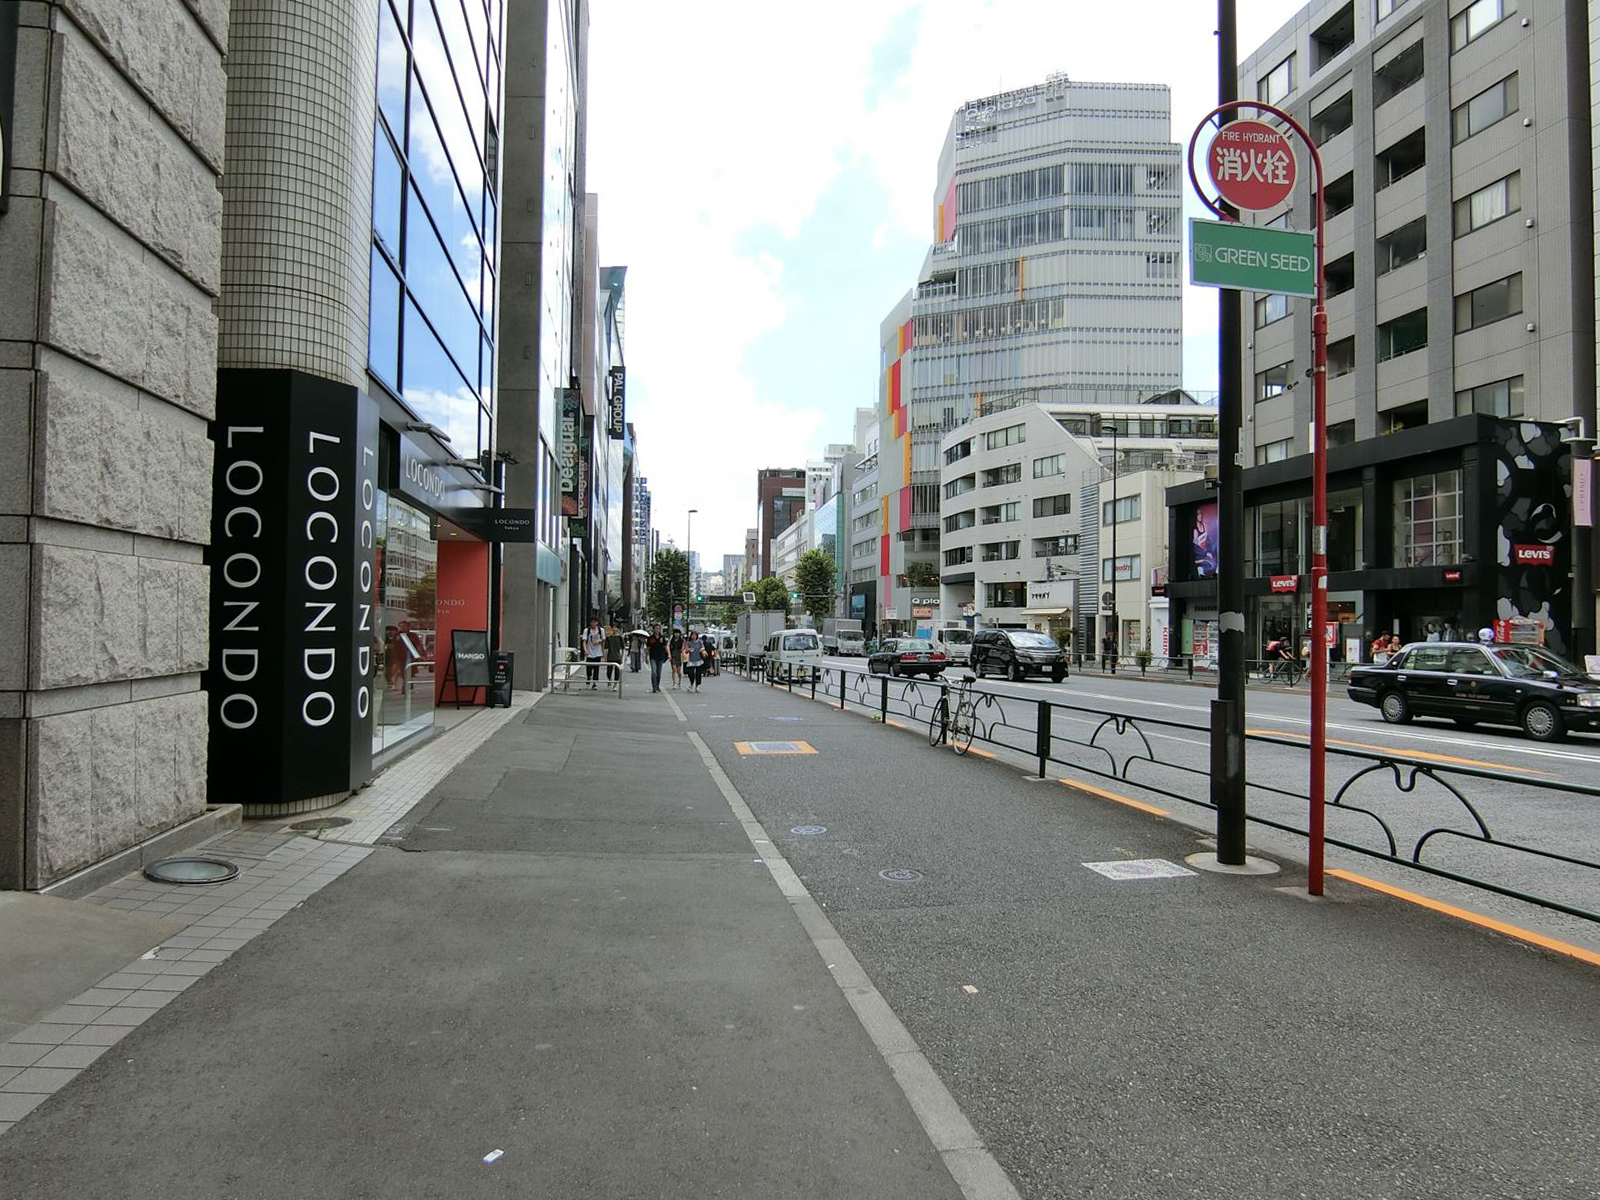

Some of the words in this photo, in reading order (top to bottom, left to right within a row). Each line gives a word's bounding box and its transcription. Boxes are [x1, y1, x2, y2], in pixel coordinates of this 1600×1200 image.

[1222, 131, 1240, 142] FIRE
[1242, 132, 1283, 144] HYDRANT
[1216, 147, 1290, 185] 消火栓
[1215, 247, 1268, 268] GREEN
[1271, 254, 1311, 273] SEED
[614, 372, 624, 392] PAL
[613, 395, 623, 433] GROUP
[405, 453, 446, 501] LOCONDO
[220, 426, 264, 729] LOCONDO
[302, 431, 341, 726] LOCONDO
[357, 446, 374, 719] LOCONDO
[458, 652, 485, 661] MANGO
